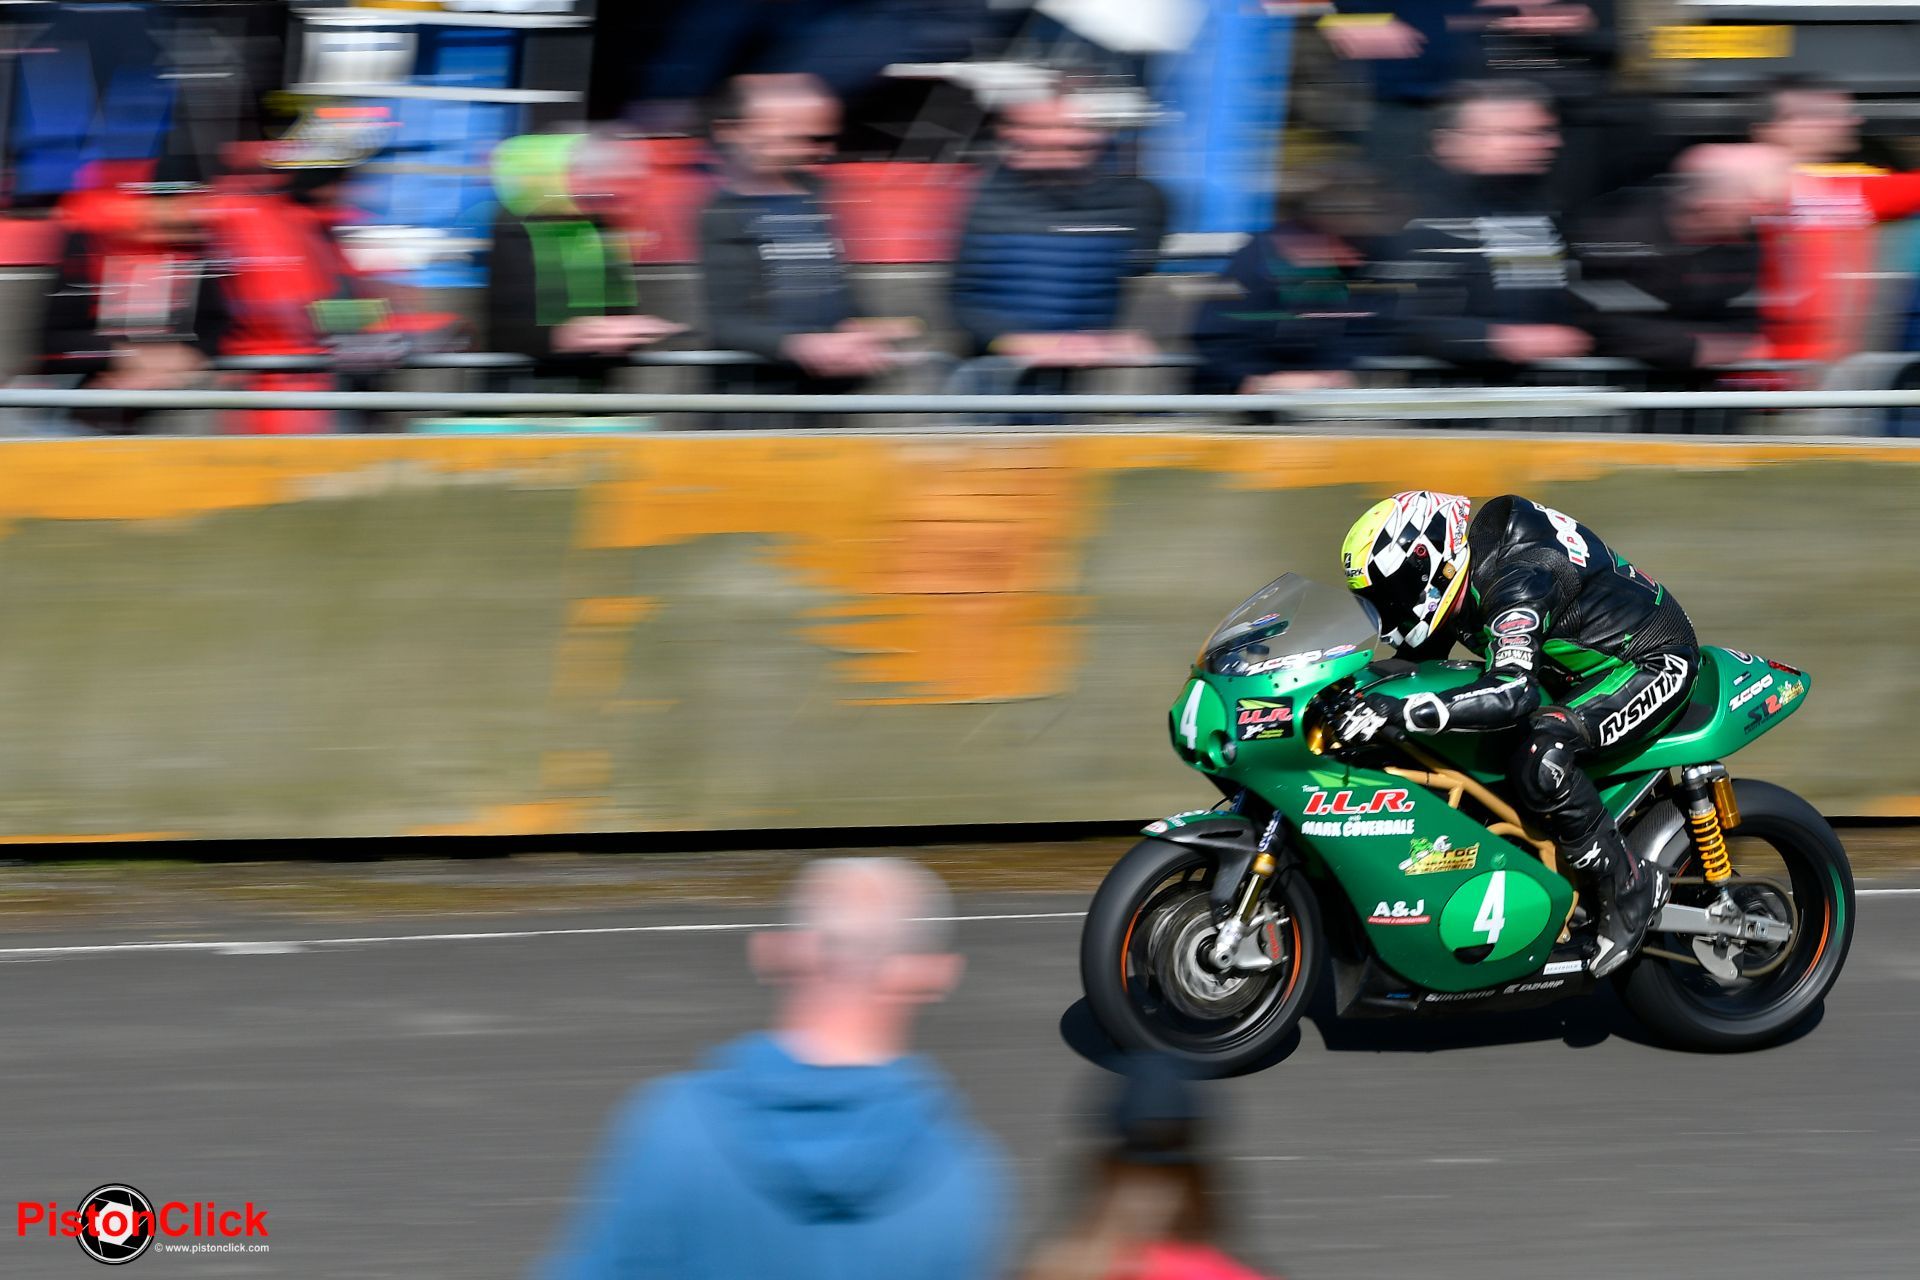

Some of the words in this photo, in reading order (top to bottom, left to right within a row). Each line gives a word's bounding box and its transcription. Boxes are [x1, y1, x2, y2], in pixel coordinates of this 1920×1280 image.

[1180, 679, 1205, 751] 4
[1303, 789, 1415, 815] I.L.R.
[1301, 821, 1342, 837] MARK
[1343, 819, 1415, 837] COVERDALE
[1372, 899, 1425, 917] A&J
[1473, 870, 1506, 944] 4
